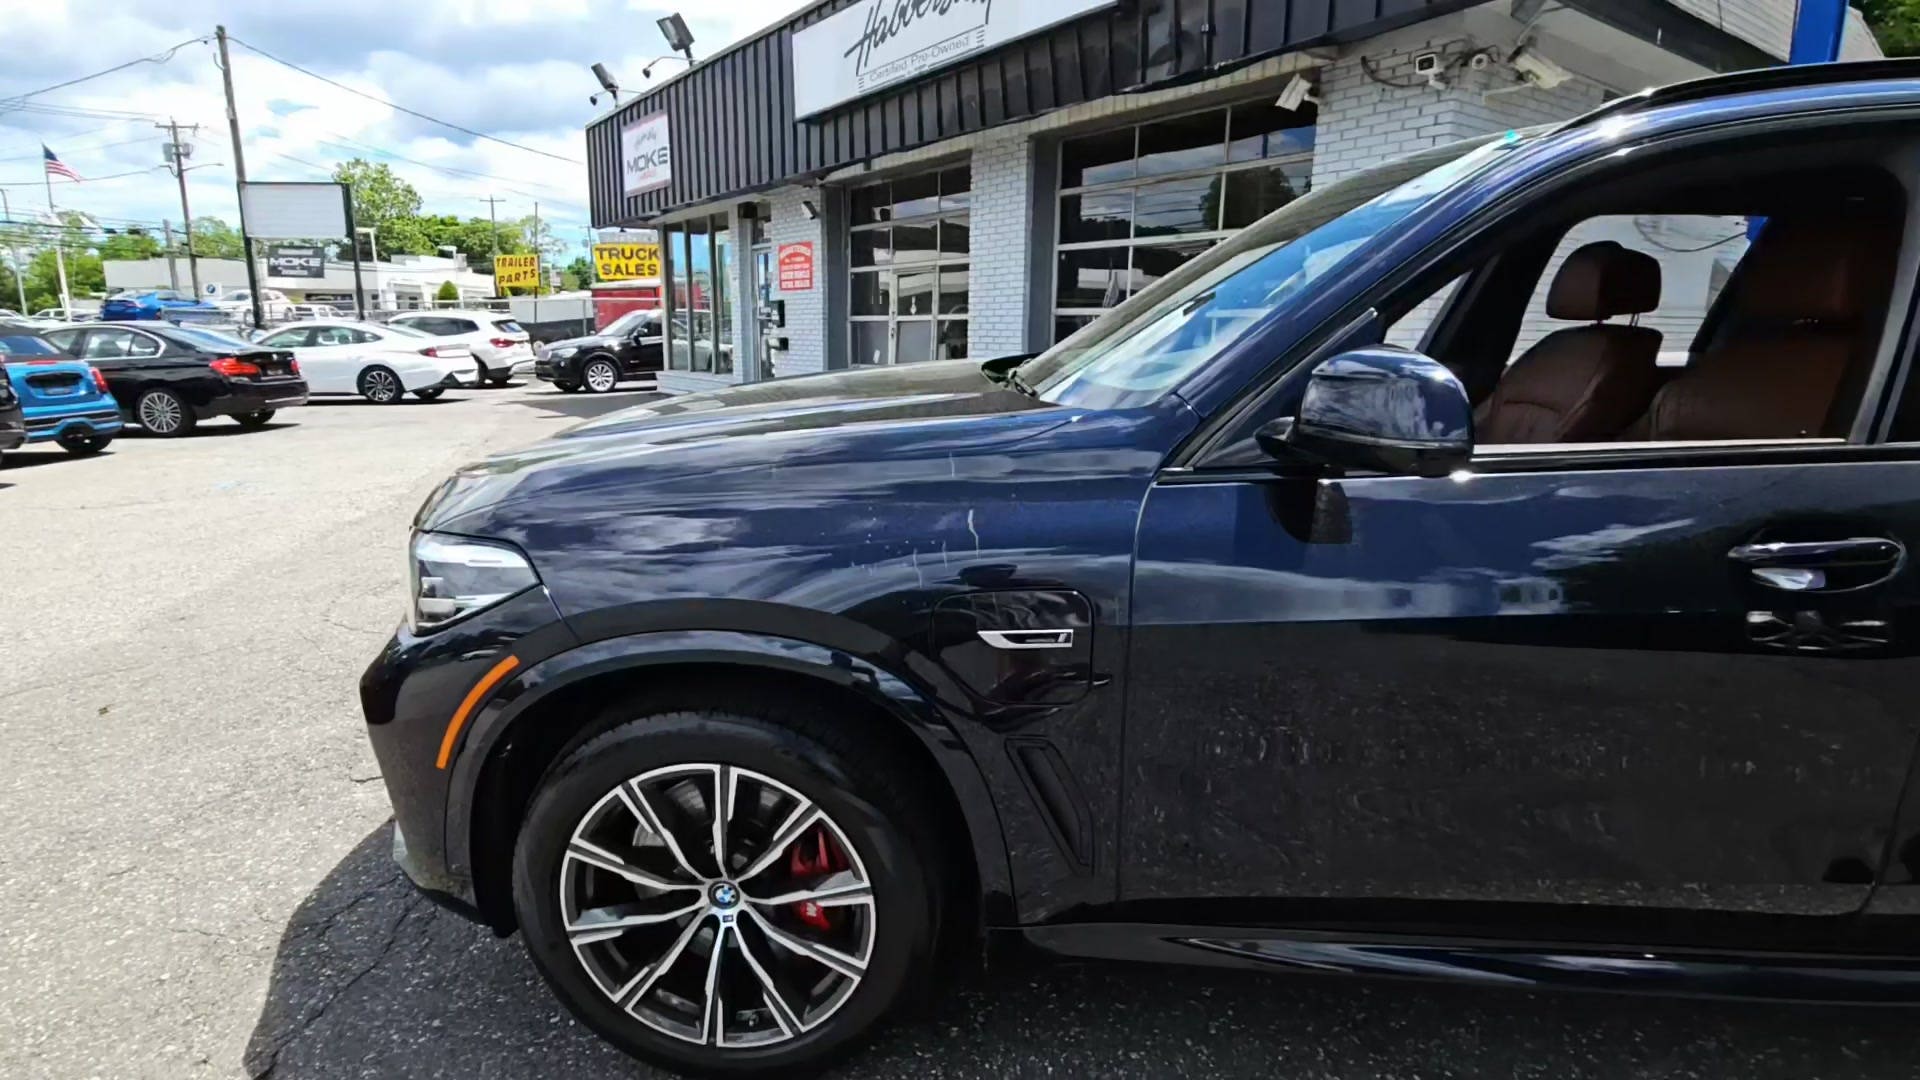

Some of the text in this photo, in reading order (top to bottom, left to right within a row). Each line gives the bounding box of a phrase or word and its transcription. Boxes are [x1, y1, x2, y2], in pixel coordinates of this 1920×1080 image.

[626, 146, 668, 174] MOKE
[595, 247, 660, 261] TRUCK
[269, 257, 321, 267] MOKE
[496, 256, 535, 268] TRAILER
[498, 268, 536, 284] PARTS
[601, 263, 657, 276] SALES
